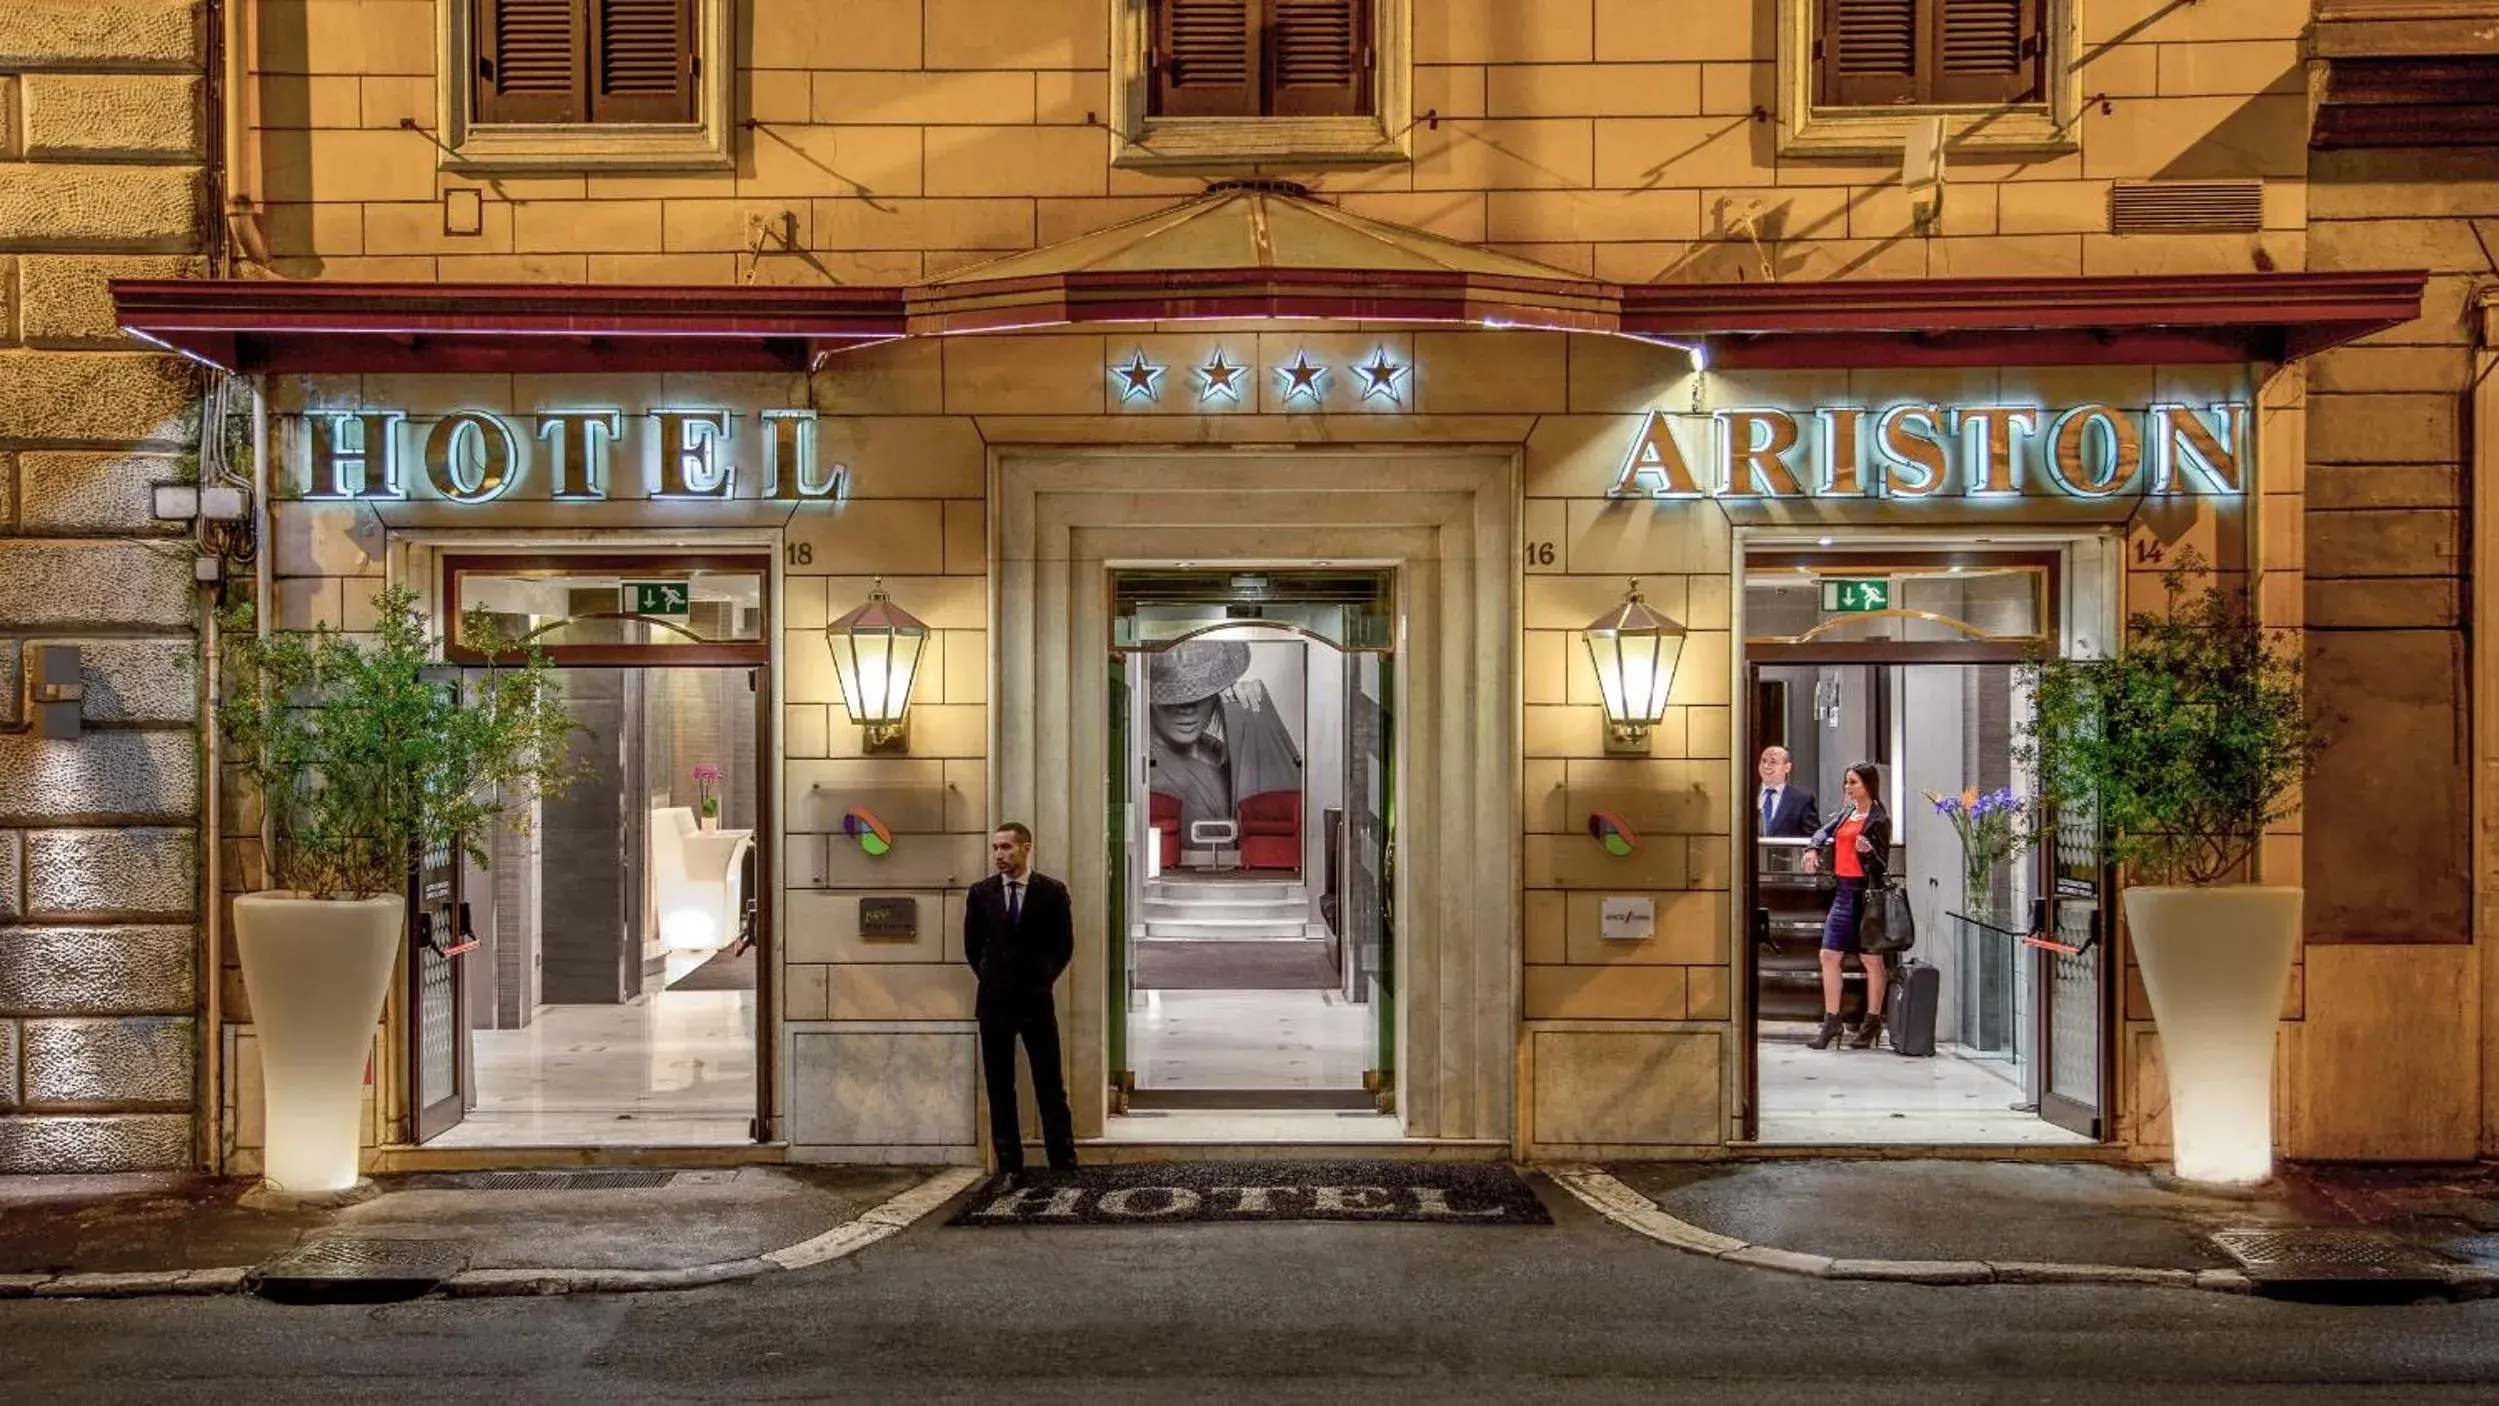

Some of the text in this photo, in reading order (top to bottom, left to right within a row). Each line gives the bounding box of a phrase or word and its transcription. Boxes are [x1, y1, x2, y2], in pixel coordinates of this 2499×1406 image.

[302, 407, 848, 504] HOTEL
[1607, 400, 2248, 501] ARISTON
[786, 542, 813, 566] 18
[1526, 542, 1556, 566] 16
[2135, 538, 2165, 563] 14
[970, 1186, 1504, 1217] HOTEL
